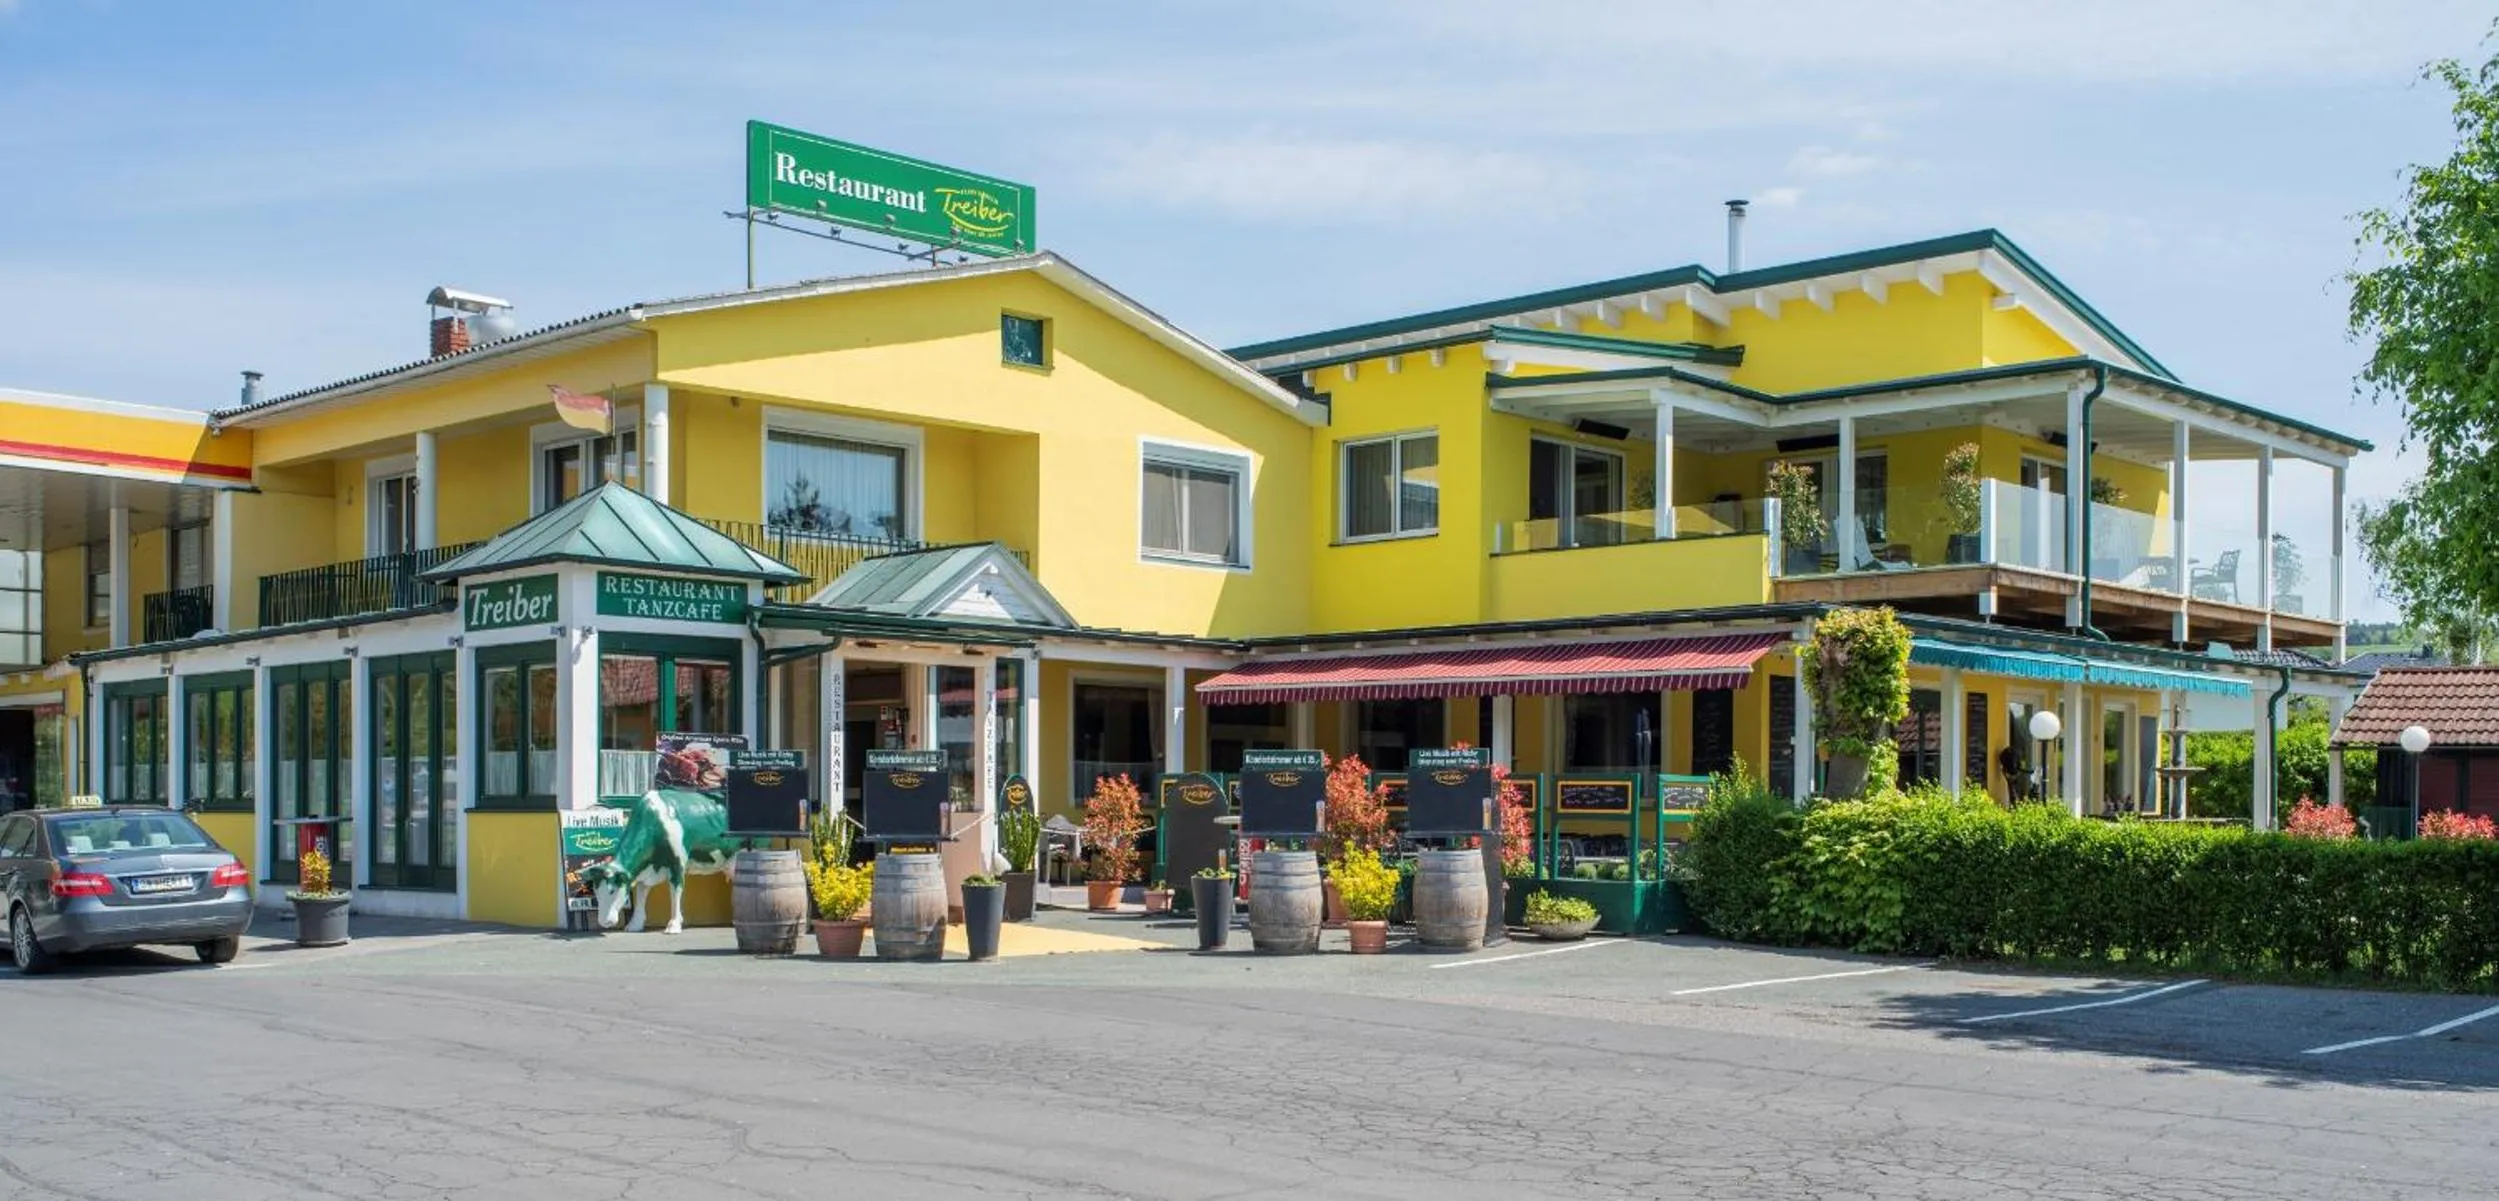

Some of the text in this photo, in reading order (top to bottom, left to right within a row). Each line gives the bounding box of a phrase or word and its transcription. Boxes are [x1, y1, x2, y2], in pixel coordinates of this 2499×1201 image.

[774, 150, 927, 213] Restaurant
[934, 187, 1014, 231] Treiber
[467, 583, 553, 627] Treiber
[604, 575, 739, 601] RESTAURANT
[623, 597, 723, 621] TANZCAFE
[832, 674, 842, 793] RESTAURANT
[567, 815, 620, 827] Live Musik
